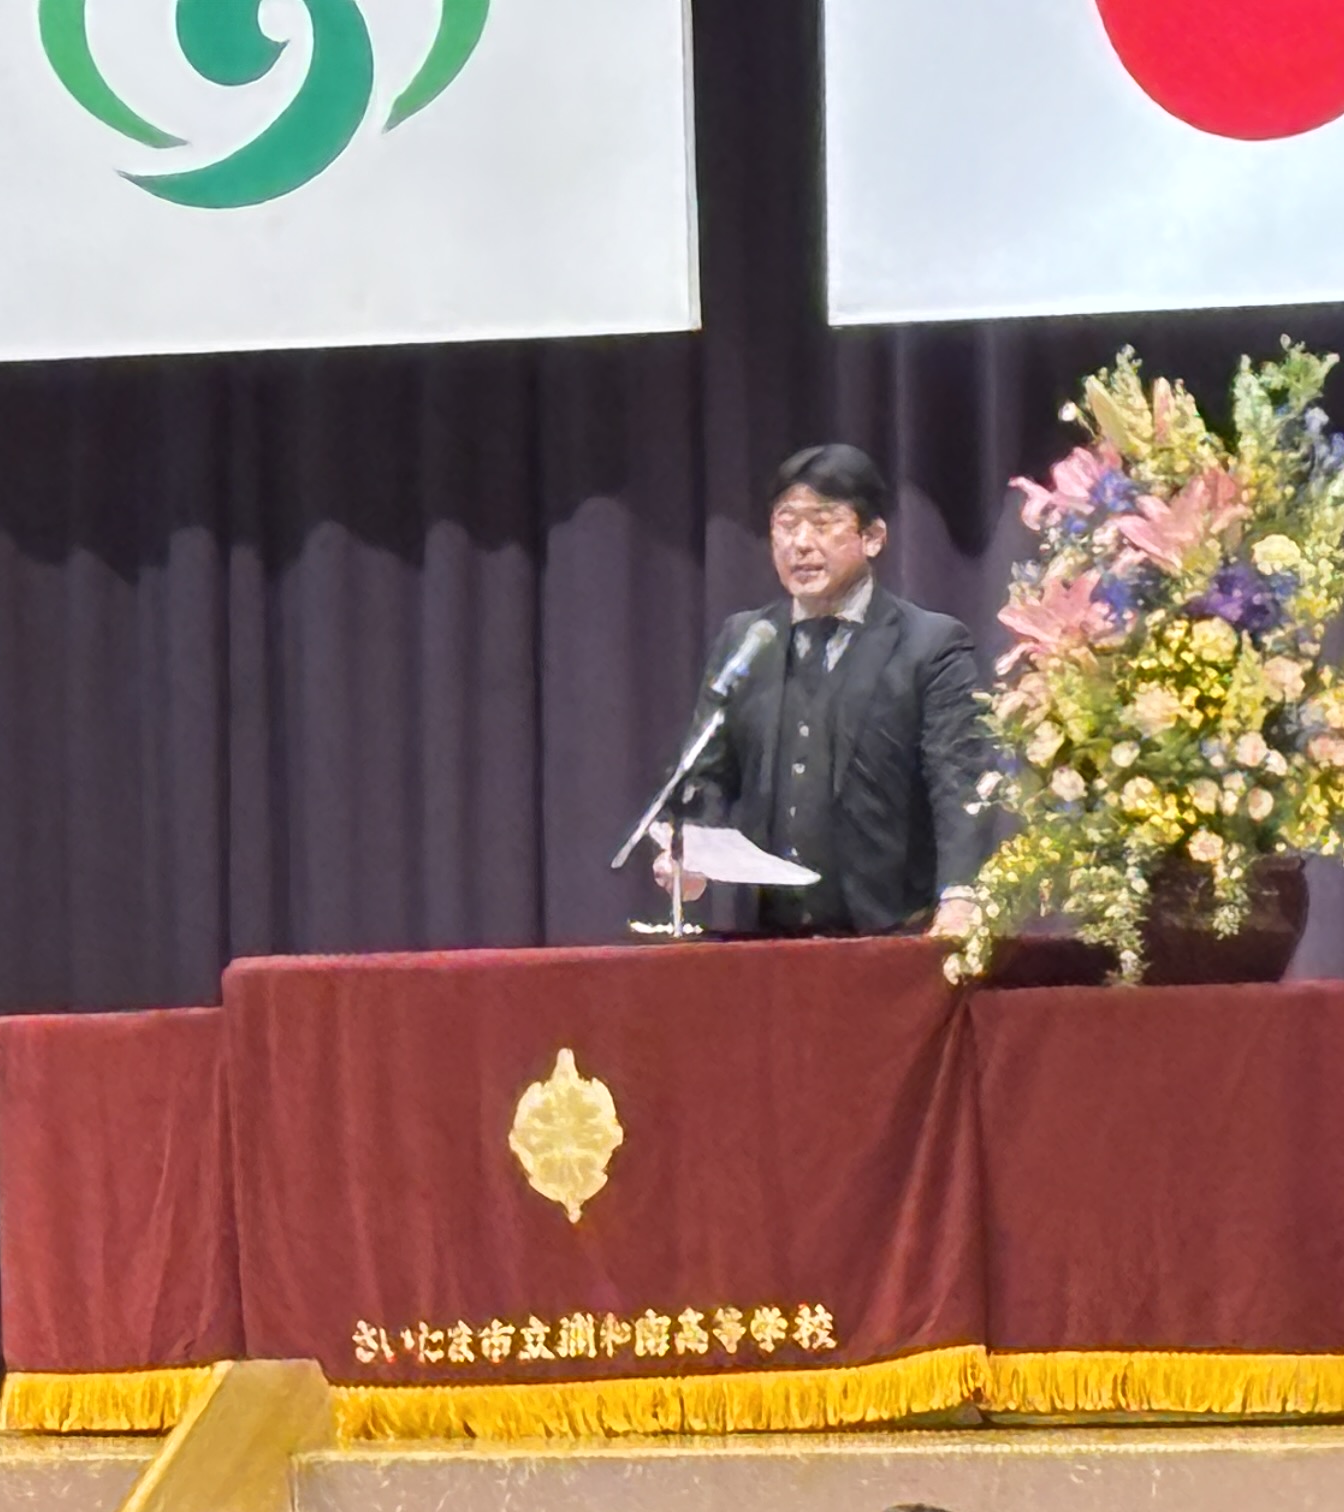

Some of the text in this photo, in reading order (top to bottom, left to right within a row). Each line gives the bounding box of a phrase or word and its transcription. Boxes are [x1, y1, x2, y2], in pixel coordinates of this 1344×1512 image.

[352, 1303, 837, 1363] さいたま市立浦和南高等学校
